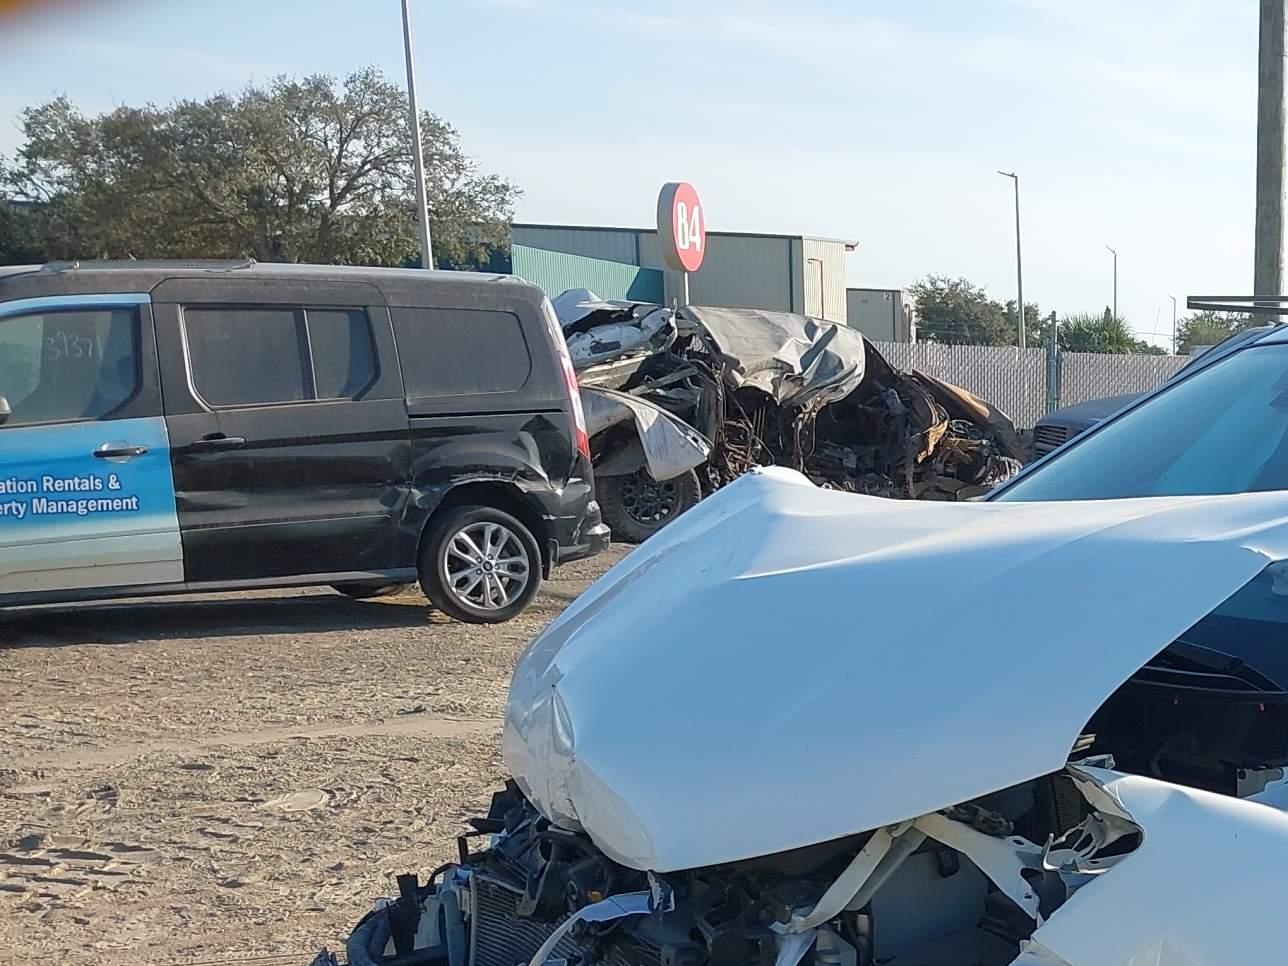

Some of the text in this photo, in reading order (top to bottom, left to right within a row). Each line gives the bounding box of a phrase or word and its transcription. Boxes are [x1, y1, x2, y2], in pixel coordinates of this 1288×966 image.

[677, 201, 702, 252] B4
[42, 474, 103, 492] Rentals
[108, 473, 121, 490] &
[32, 494, 138, 515] Management
